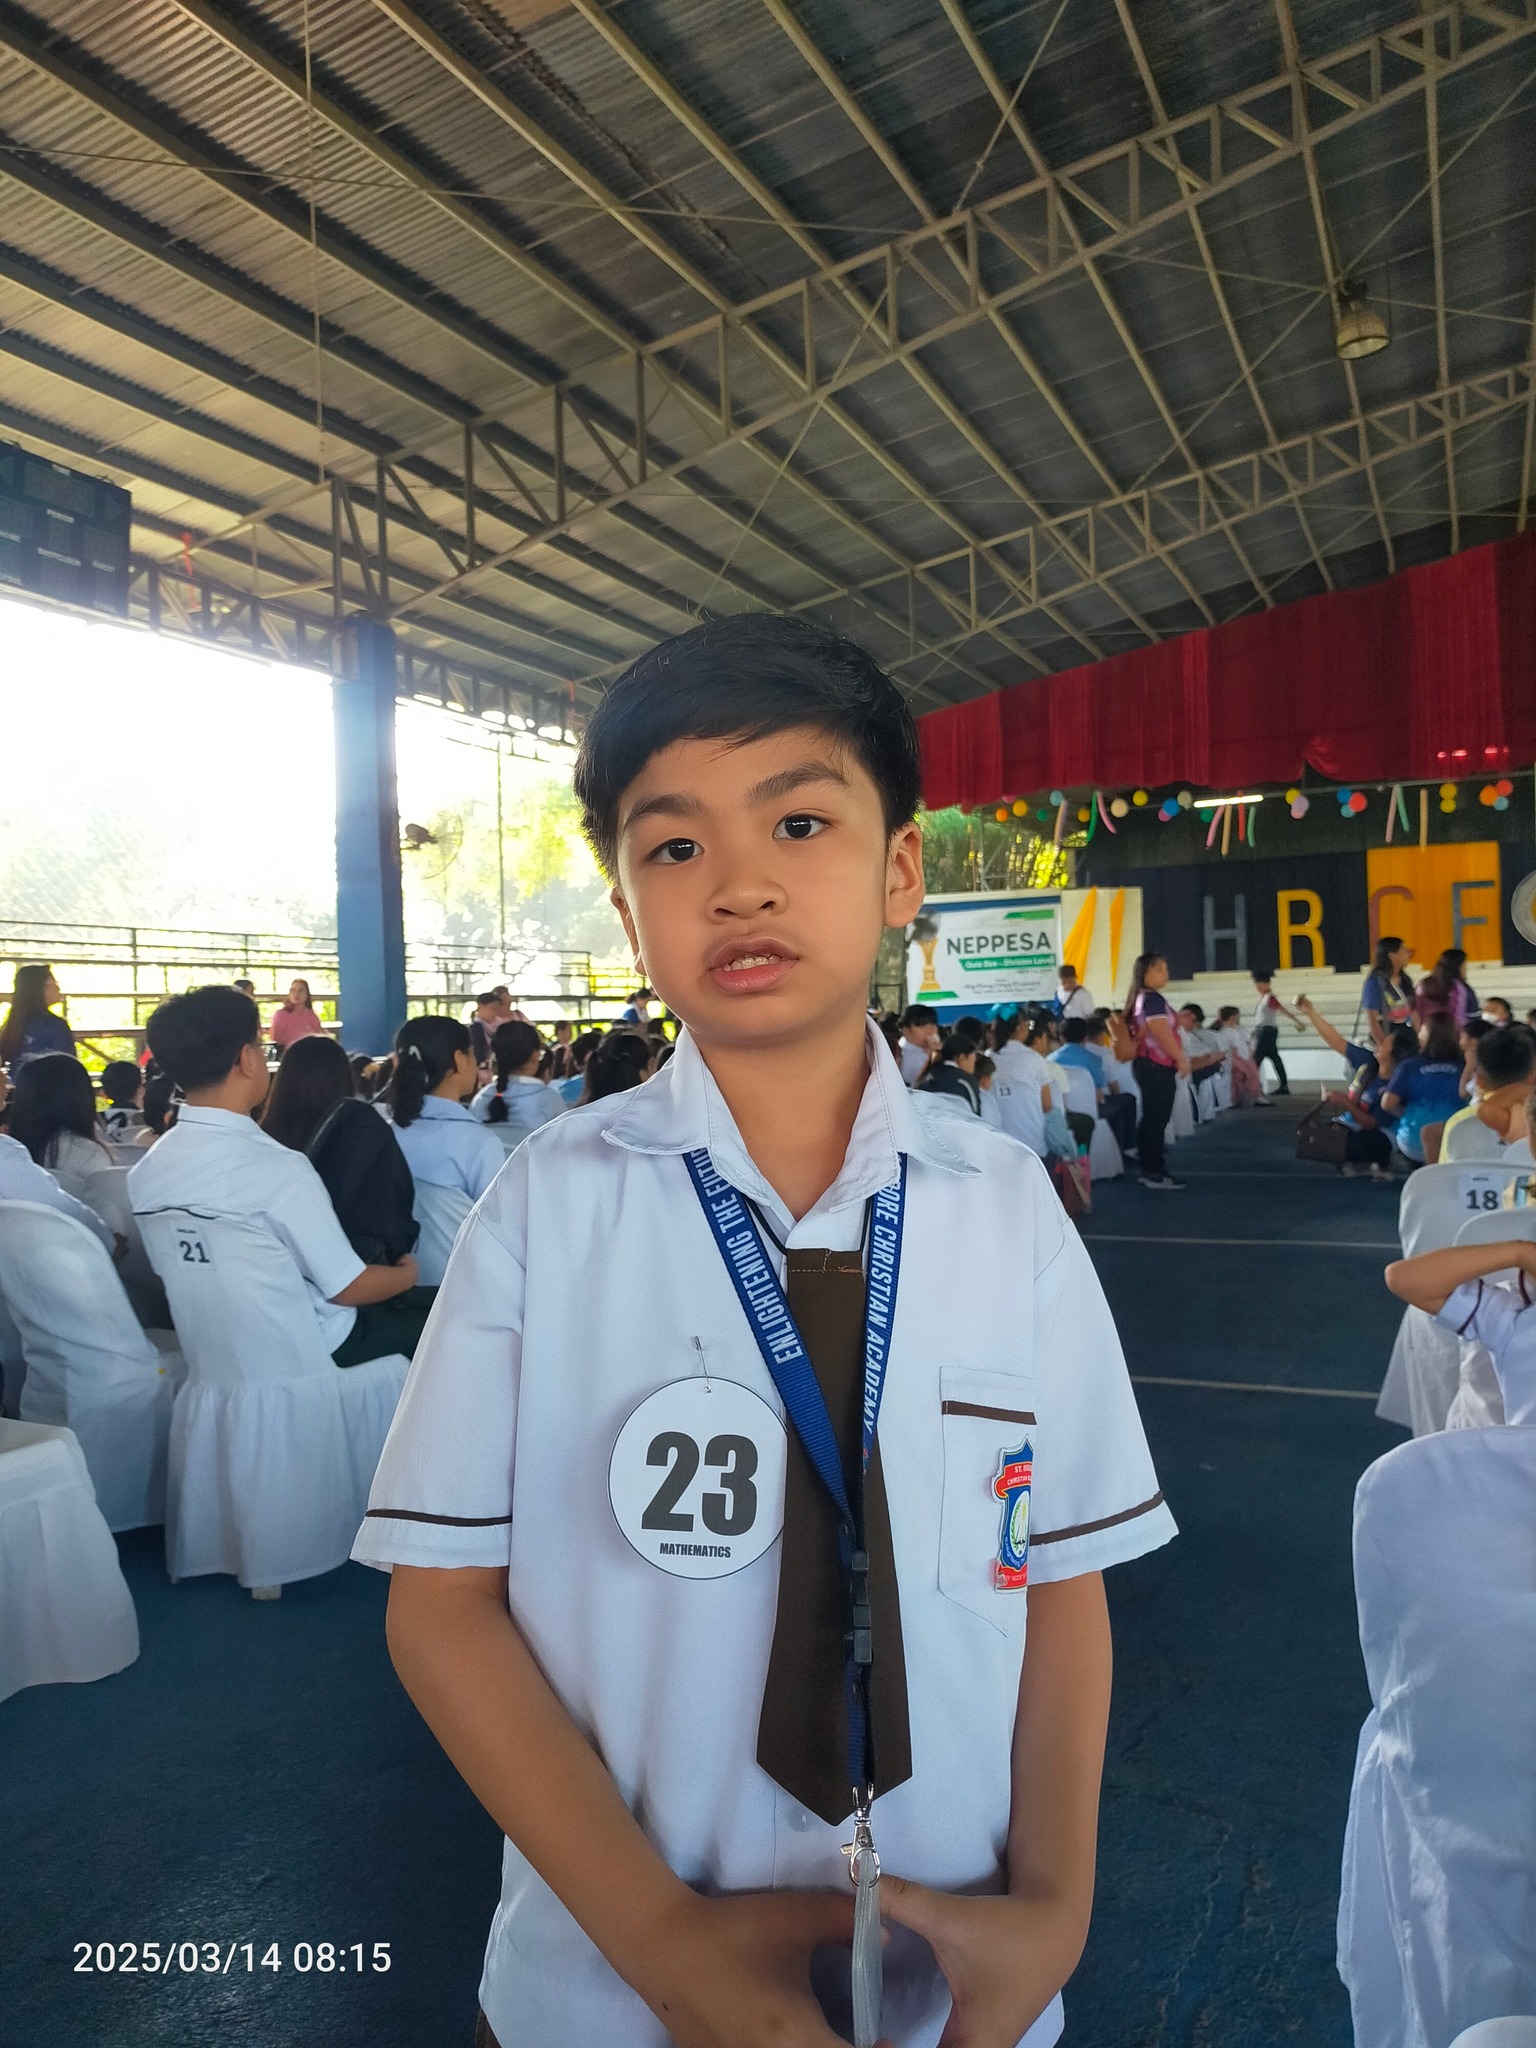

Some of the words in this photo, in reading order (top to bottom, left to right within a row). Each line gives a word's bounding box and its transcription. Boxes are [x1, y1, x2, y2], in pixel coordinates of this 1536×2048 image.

[946, 932, 1051, 956] NEPPESA
[711, 1193, 746, 1234] THE
[1466, 1189, 1499, 1211] 18
[179, 1240, 211, 1264] 21
[726, 1230, 804, 1365] ENLIGHTENING
[868, 1225, 897, 1330] CHRISTIAN
[863, 1328, 886, 1434] ACADEMY
[641, 1431, 758, 1536] 23
[659, 1542, 731, 1558] MATHEMATICS
